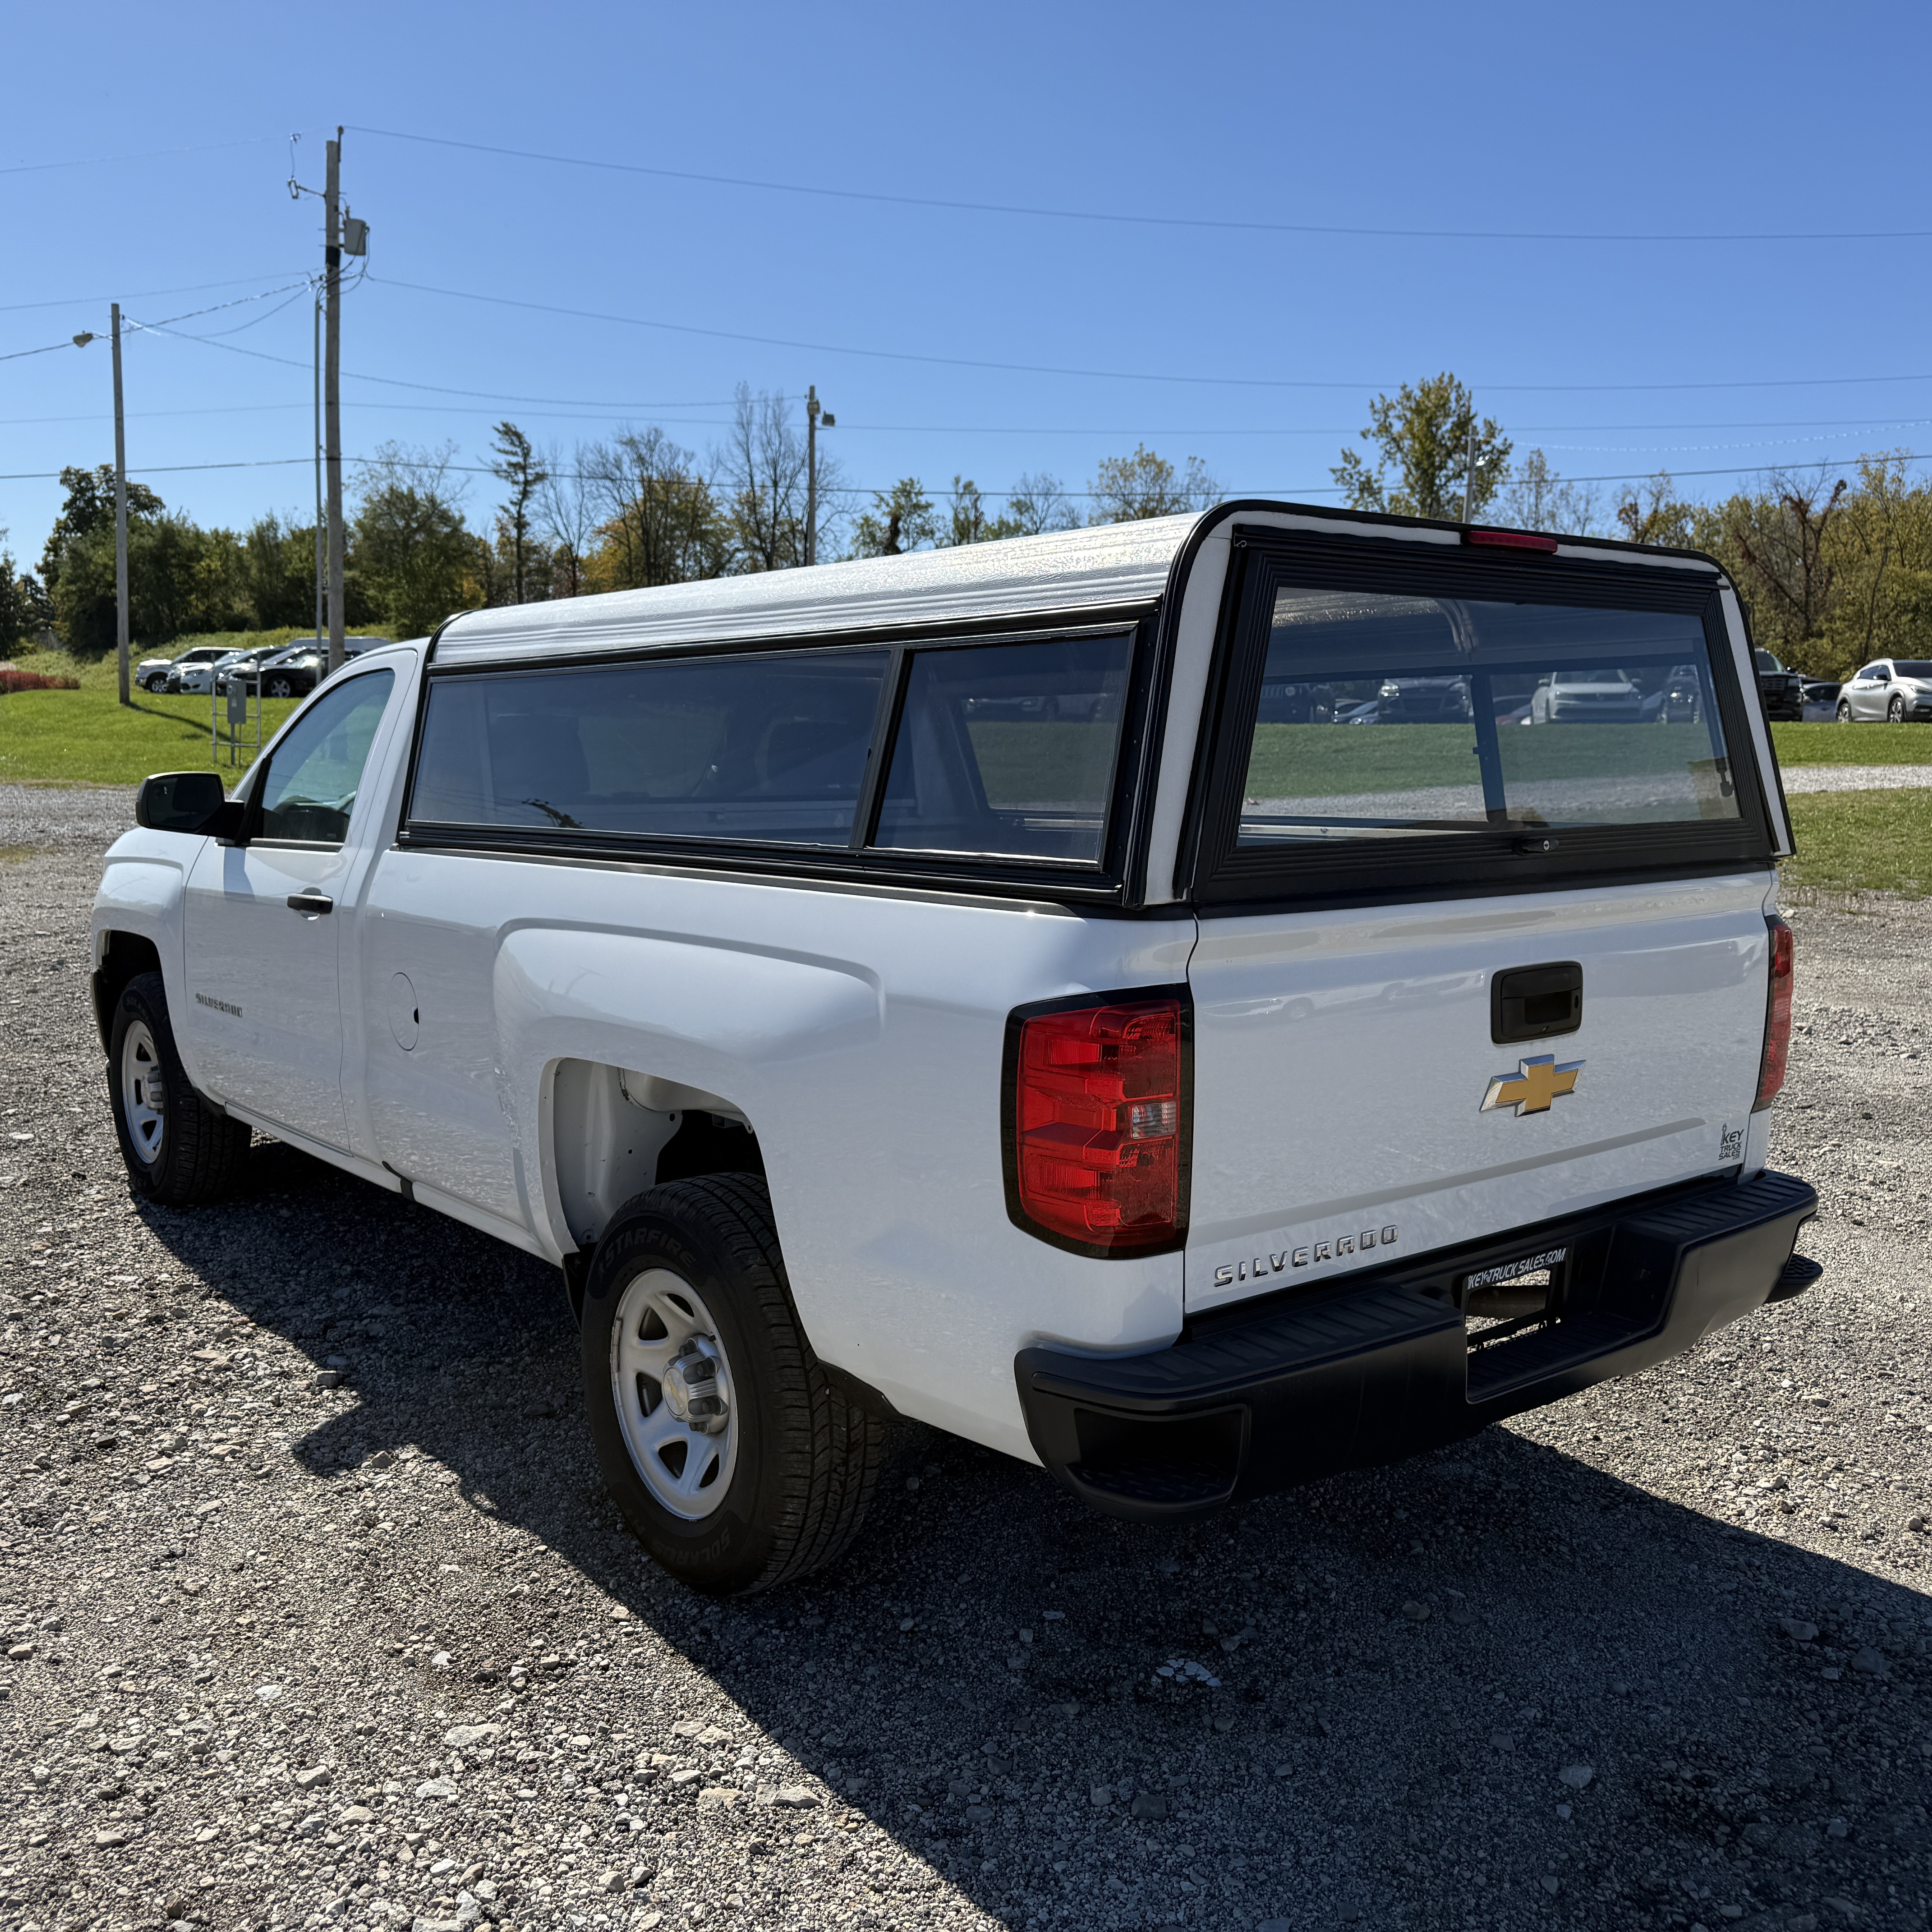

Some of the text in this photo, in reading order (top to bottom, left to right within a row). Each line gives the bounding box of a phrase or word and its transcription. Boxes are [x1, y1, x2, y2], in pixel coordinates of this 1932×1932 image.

[195, 993, 243, 1018] SILVERADO
[1720, 1141, 1742, 1153] TRUCK
[1721, 1129, 1744, 1145] KEY
[1718, 1149, 1740, 1160] SALES
[605, 1227, 697, 1268] STARFIRE
[1214, 1224, 1398, 1287] SILVERADO
[1467, 1270, 1488, 1289] KEY
[1489, 1262, 1518, 1281] TRUCK
